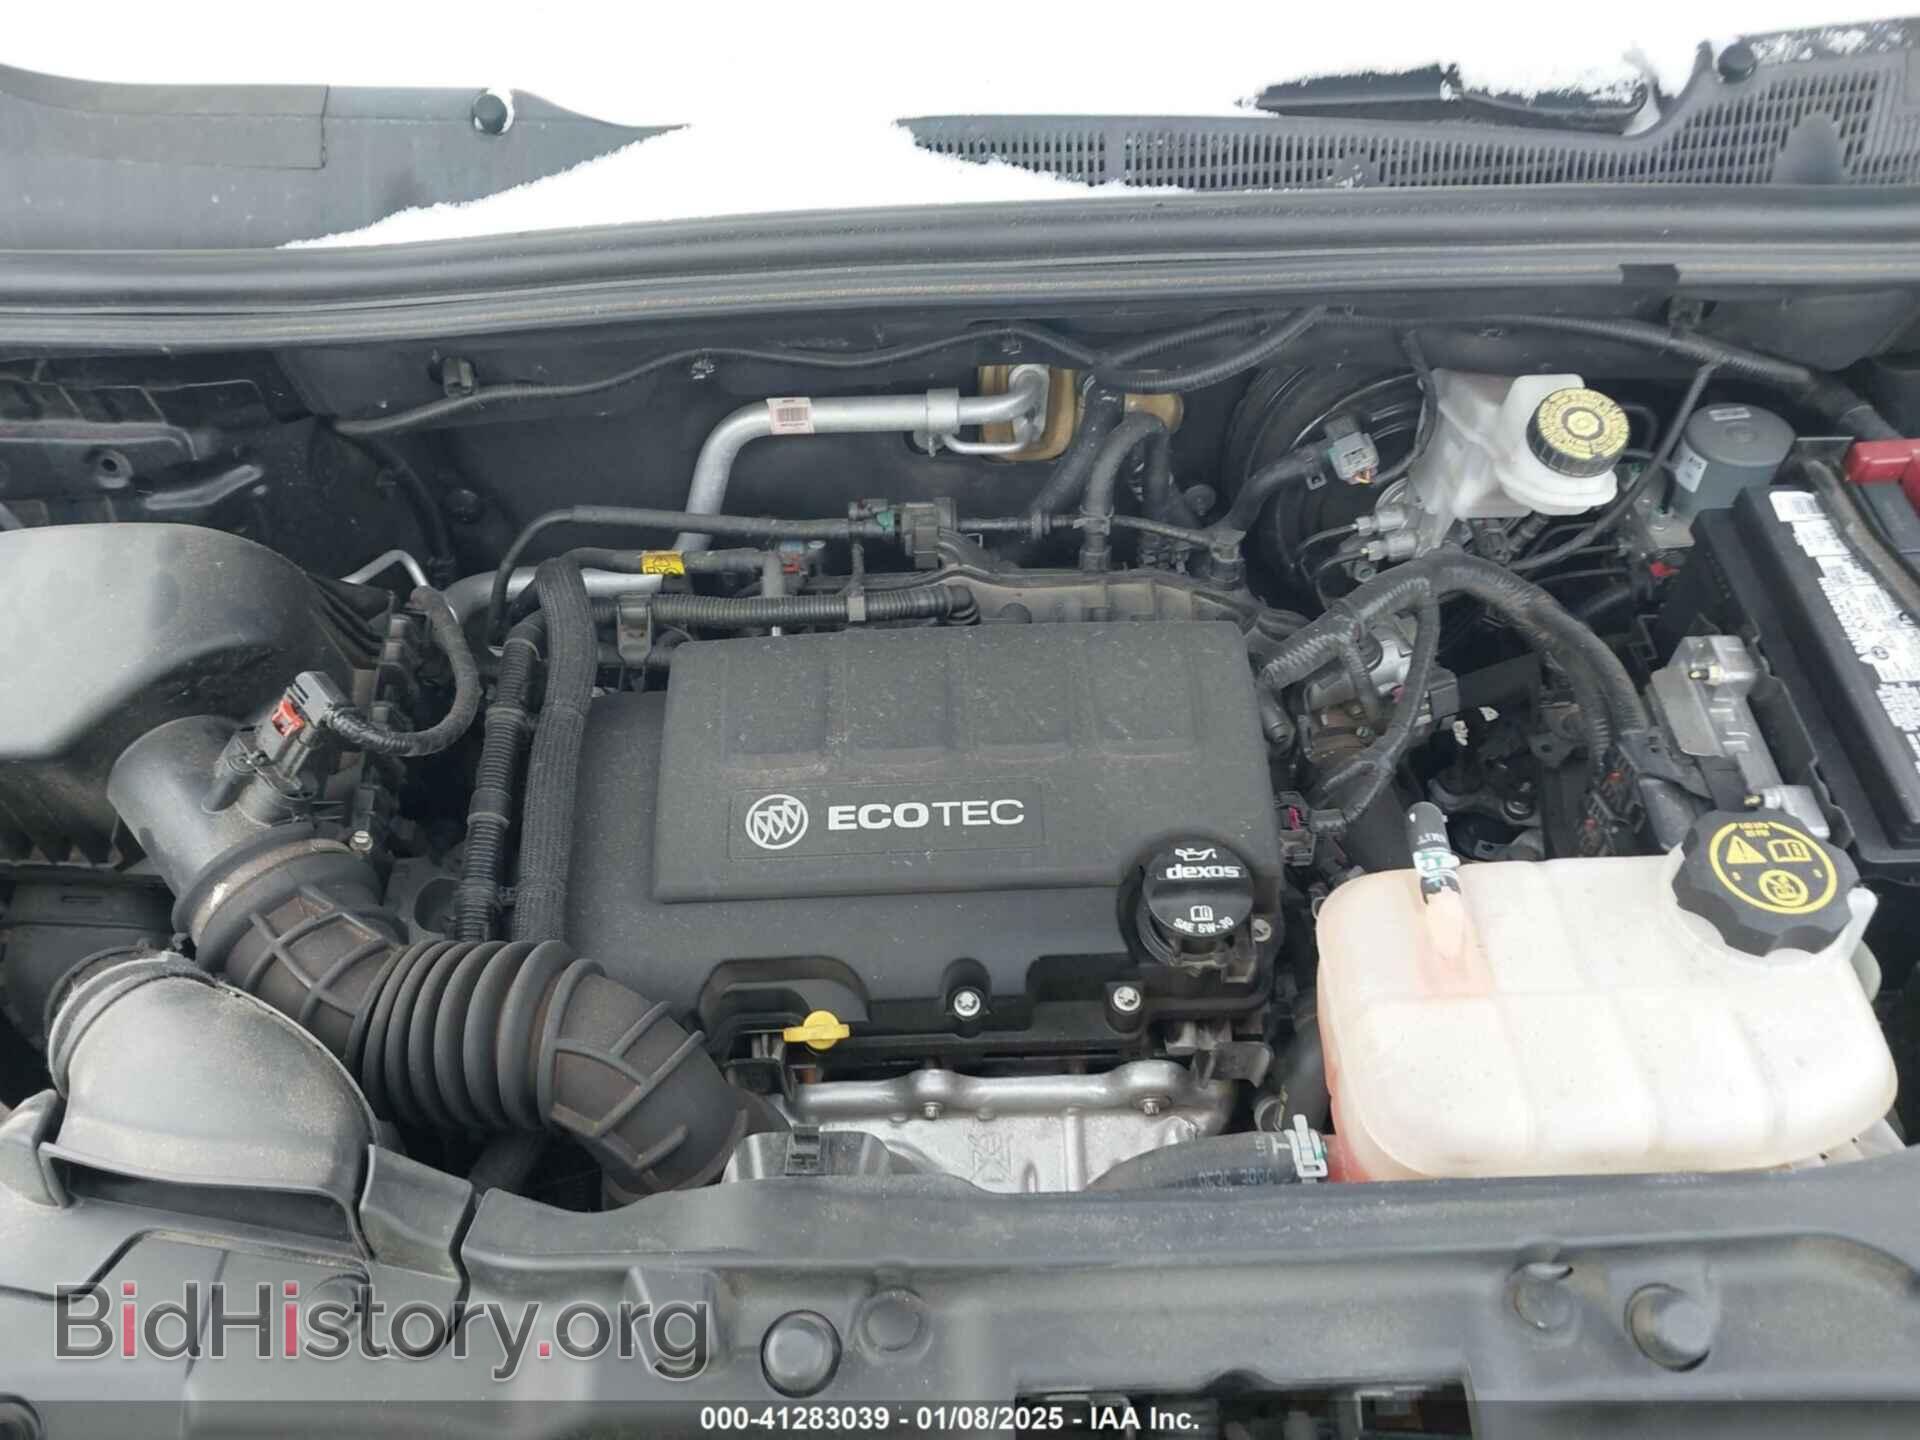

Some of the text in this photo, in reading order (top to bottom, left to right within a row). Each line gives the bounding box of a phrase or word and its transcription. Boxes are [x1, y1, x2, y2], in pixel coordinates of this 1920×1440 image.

[827, 799, 1025, 831] ECOTEC
[1166, 863, 1240, 879] dexos
[1173, 917, 1234, 933] SAE 5W-30
